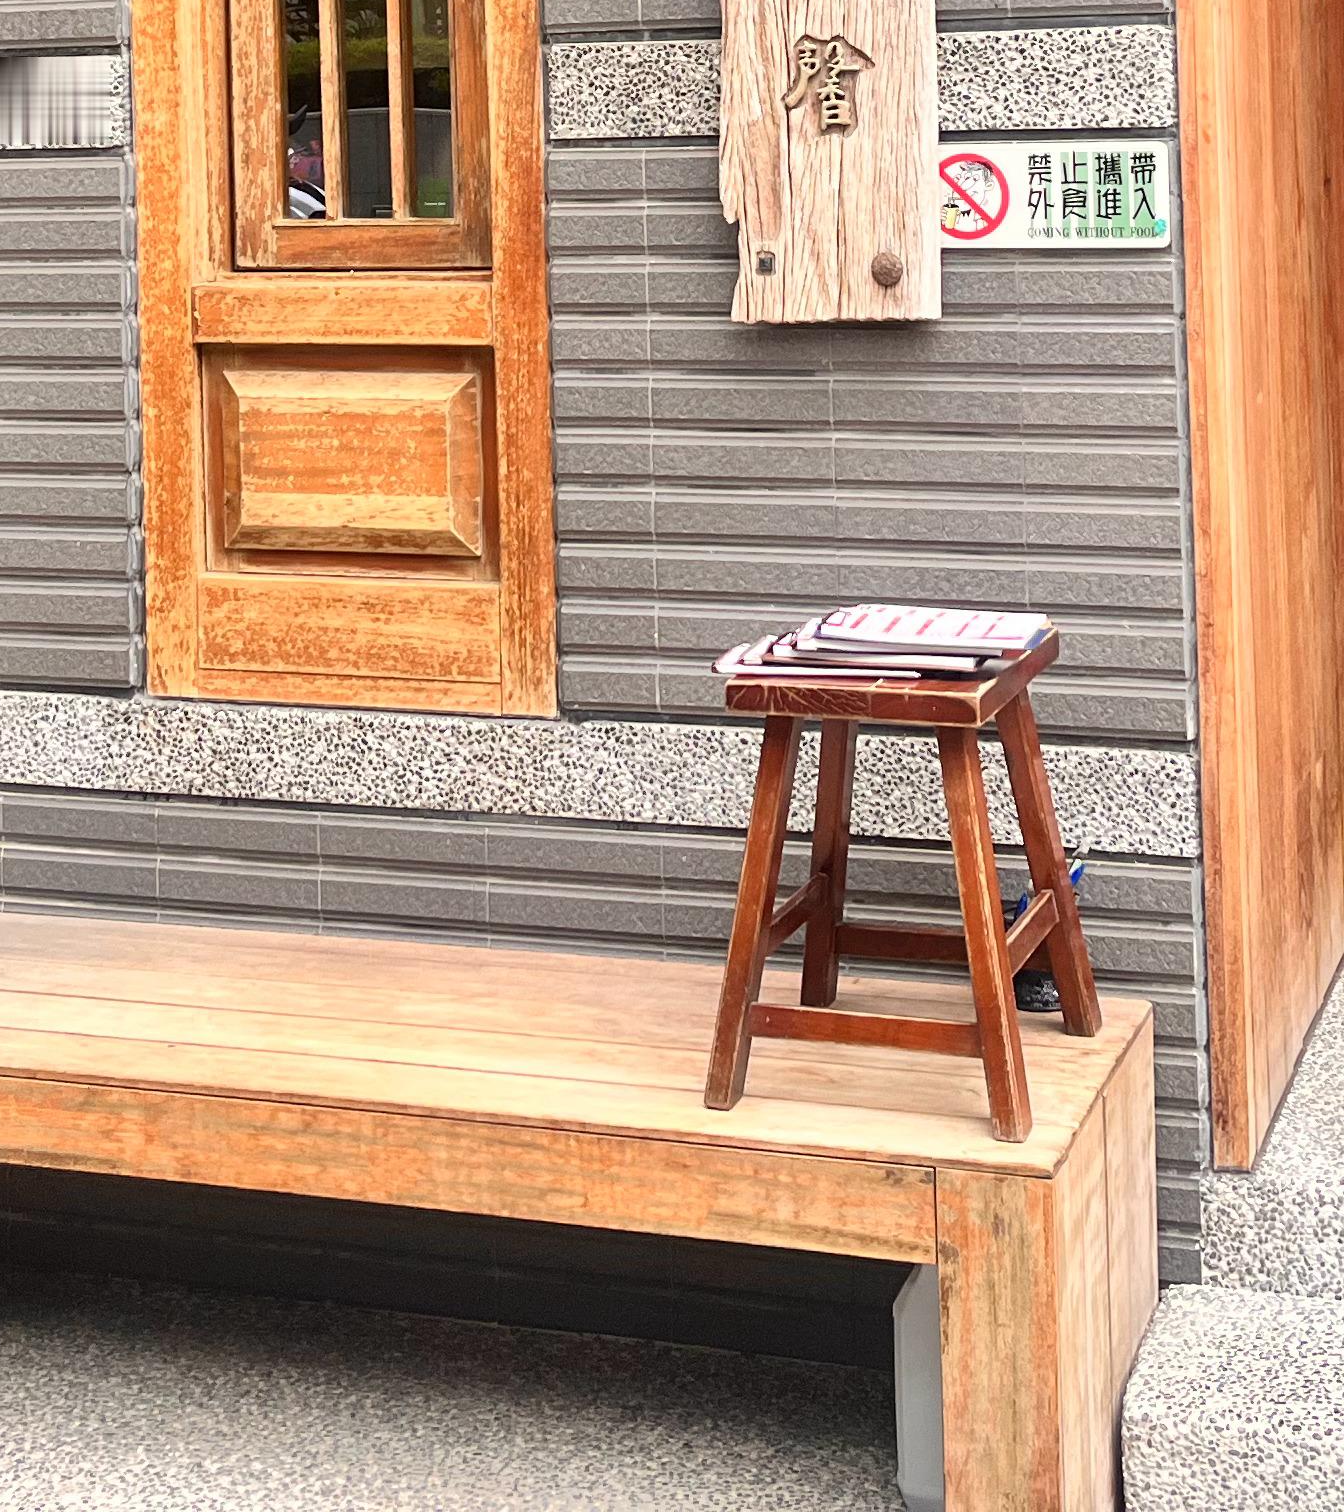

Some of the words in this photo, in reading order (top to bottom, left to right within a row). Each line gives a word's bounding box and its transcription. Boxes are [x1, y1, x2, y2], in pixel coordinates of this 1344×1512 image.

[1027, 150, 1157, 185] 禁止攜帶
[1027, 187, 1157, 220] 外食進入
[1027, 226, 1070, 239] COMING
[1074, 226, 1125, 238] WITHOUT
